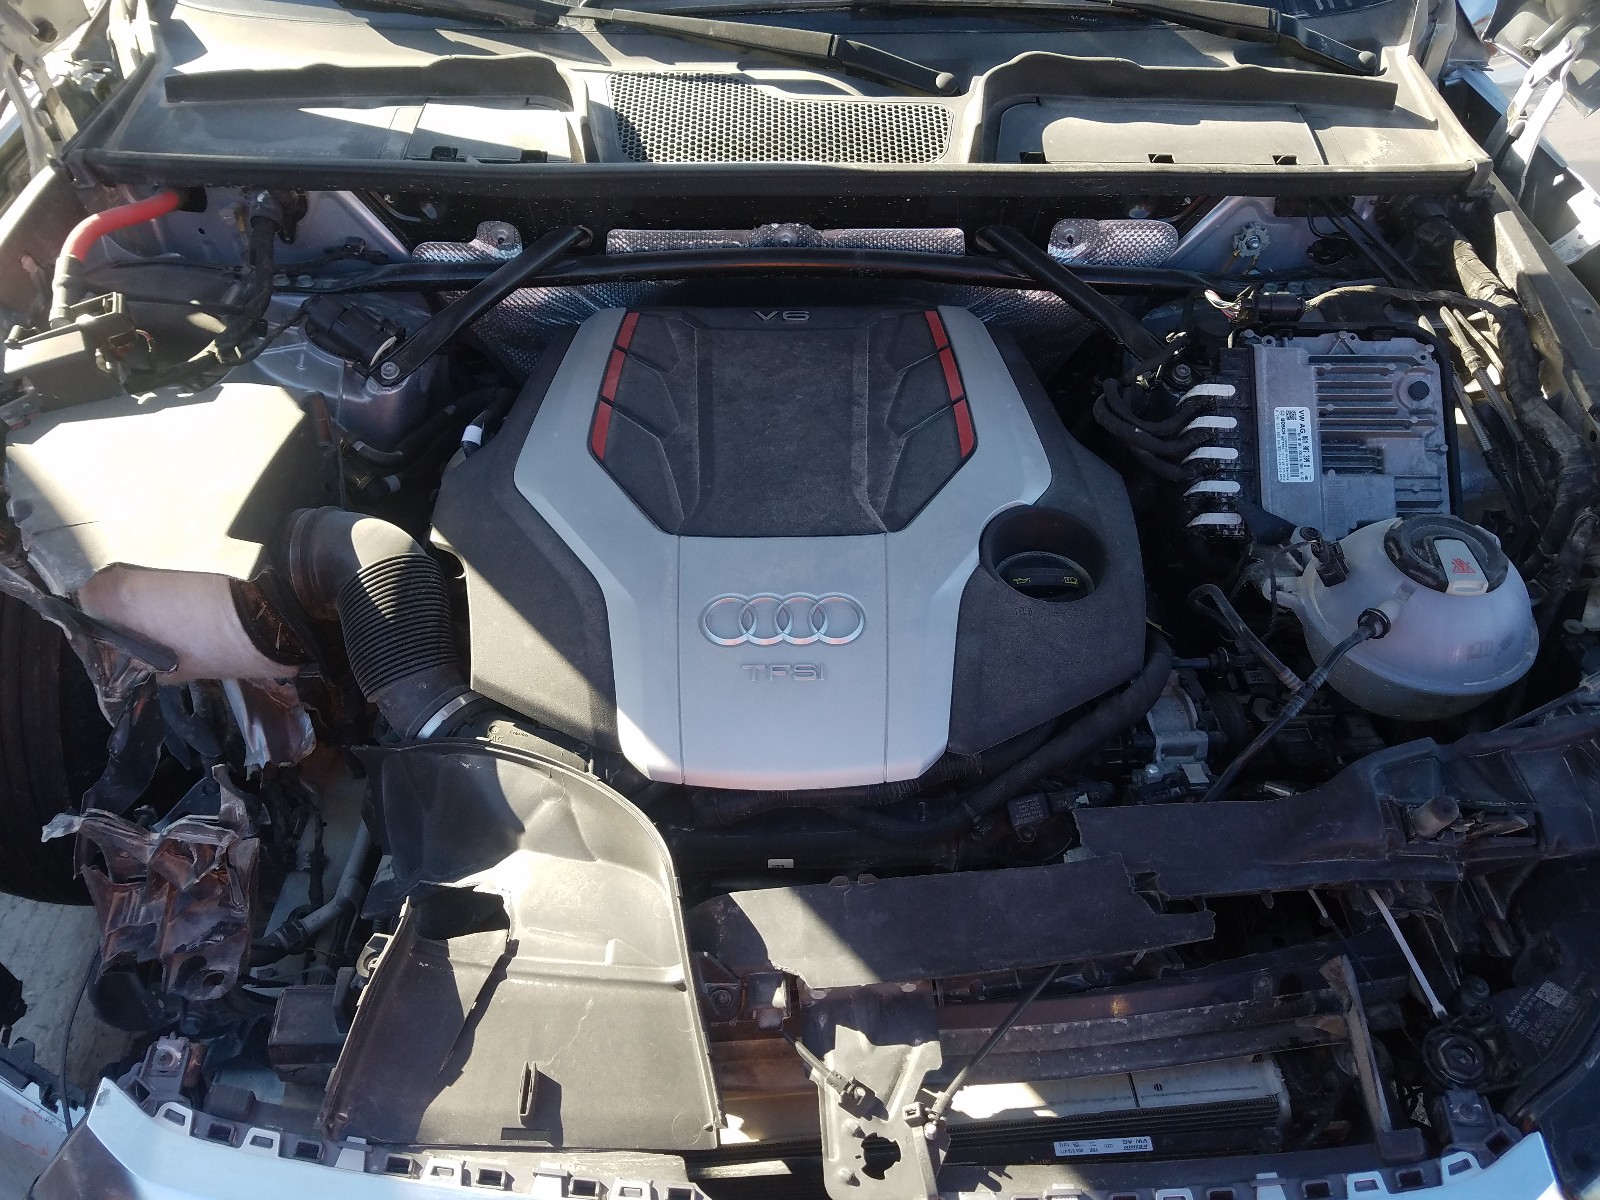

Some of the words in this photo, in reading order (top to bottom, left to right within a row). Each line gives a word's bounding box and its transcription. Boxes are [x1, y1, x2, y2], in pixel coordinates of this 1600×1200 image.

[754, 310, 810, 321] V6
[1299, 410, 1304, 421] VW
[1300, 424, 1306, 434] AG
[741, 664, 825, 682] TFSI
